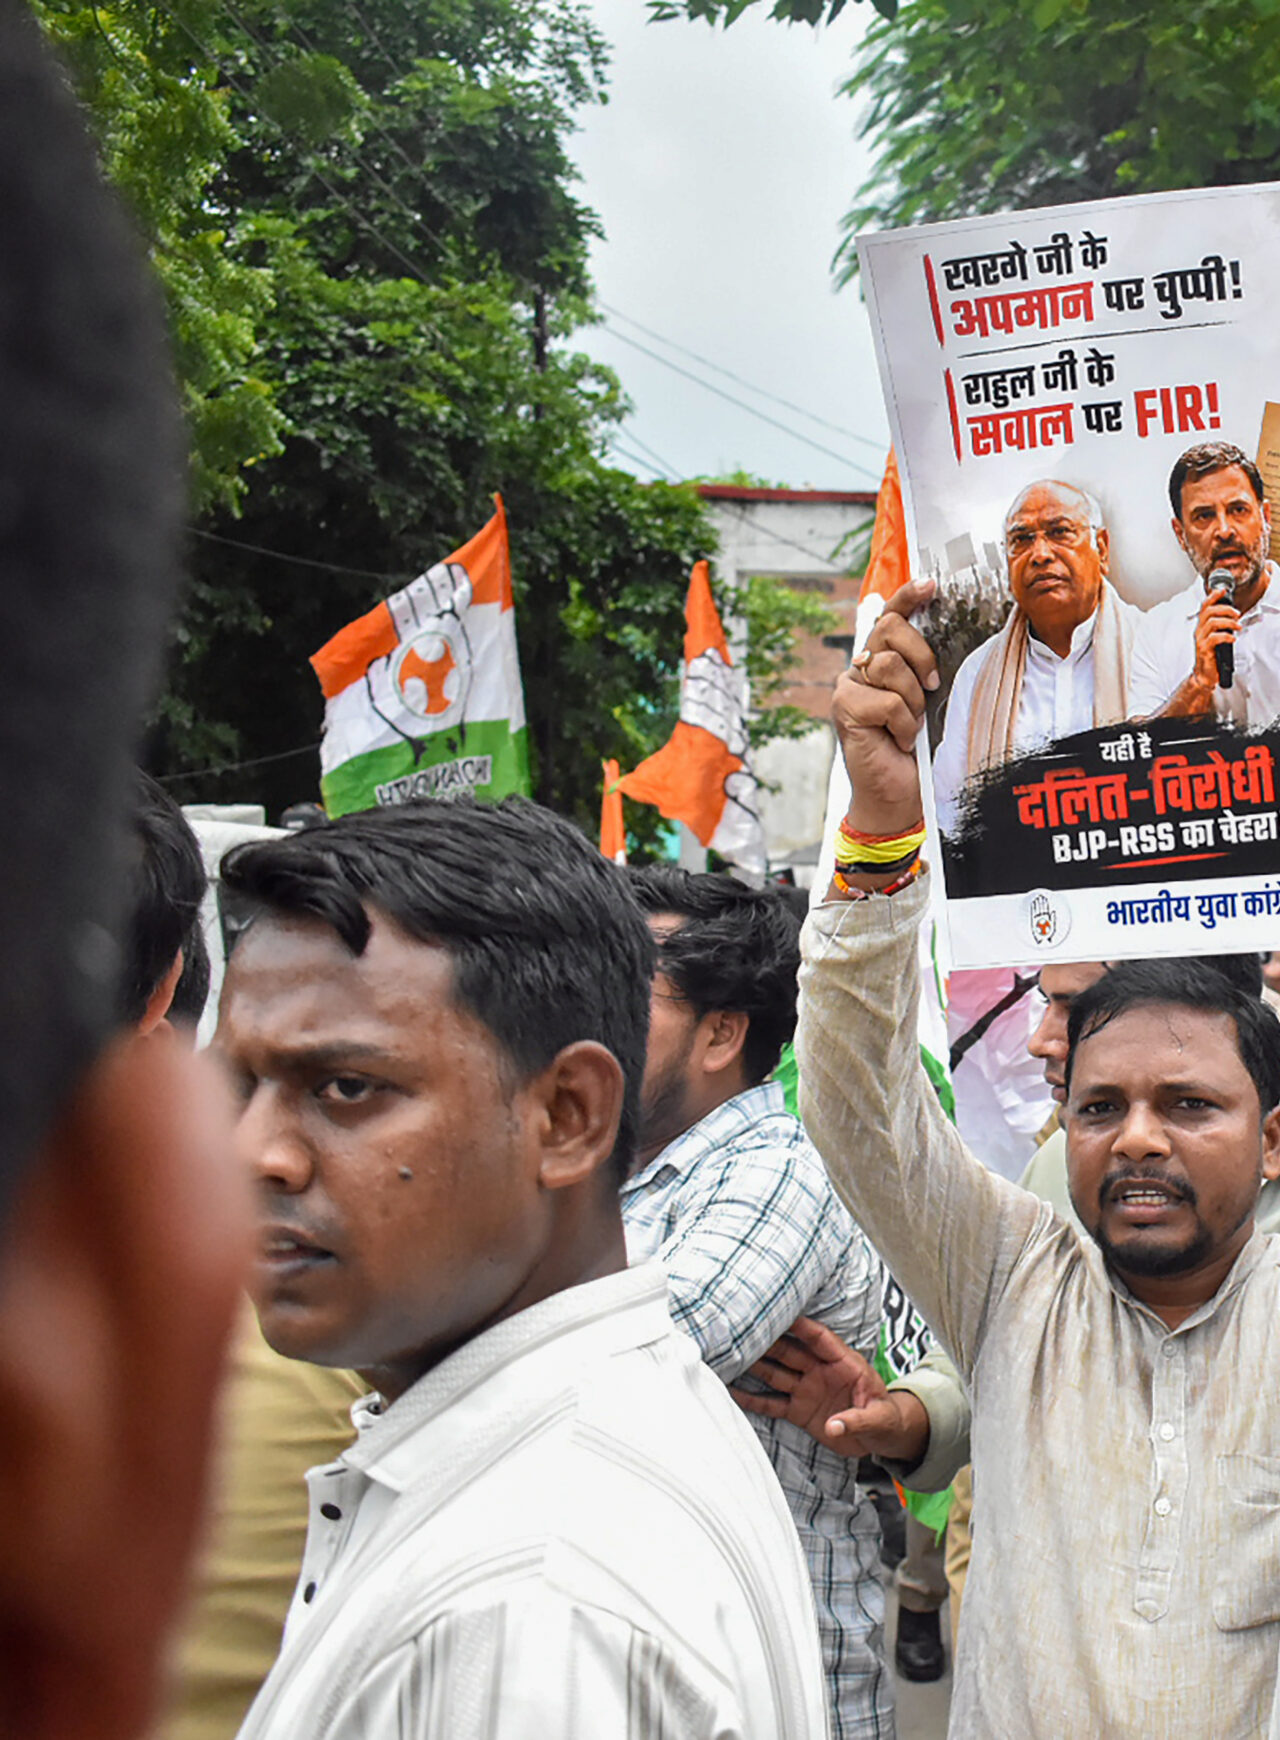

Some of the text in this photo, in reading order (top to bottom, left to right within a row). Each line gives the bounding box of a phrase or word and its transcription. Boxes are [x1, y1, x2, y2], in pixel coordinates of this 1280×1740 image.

[1033, 233, 1074, 276] जी
[1079, 231, 1108, 269] के
[950, 256, 1242, 337] अपमान पर चुप्पी!
[961, 349, 1115, 408] राहुल जी के
[966, 383, 1221, 456] सवाल पर FIR!
[1099, 732, 1153, 762] यही है
[1012, 745, 1276, 829] दलित-विरोधी
[1052, 822, 1175, 863] BJP-RSS
[1179, 819, 1214, 849] का
[1106, 889, 1191, 925] भारतीय
[1195, 893, 1238, 929] युवा
